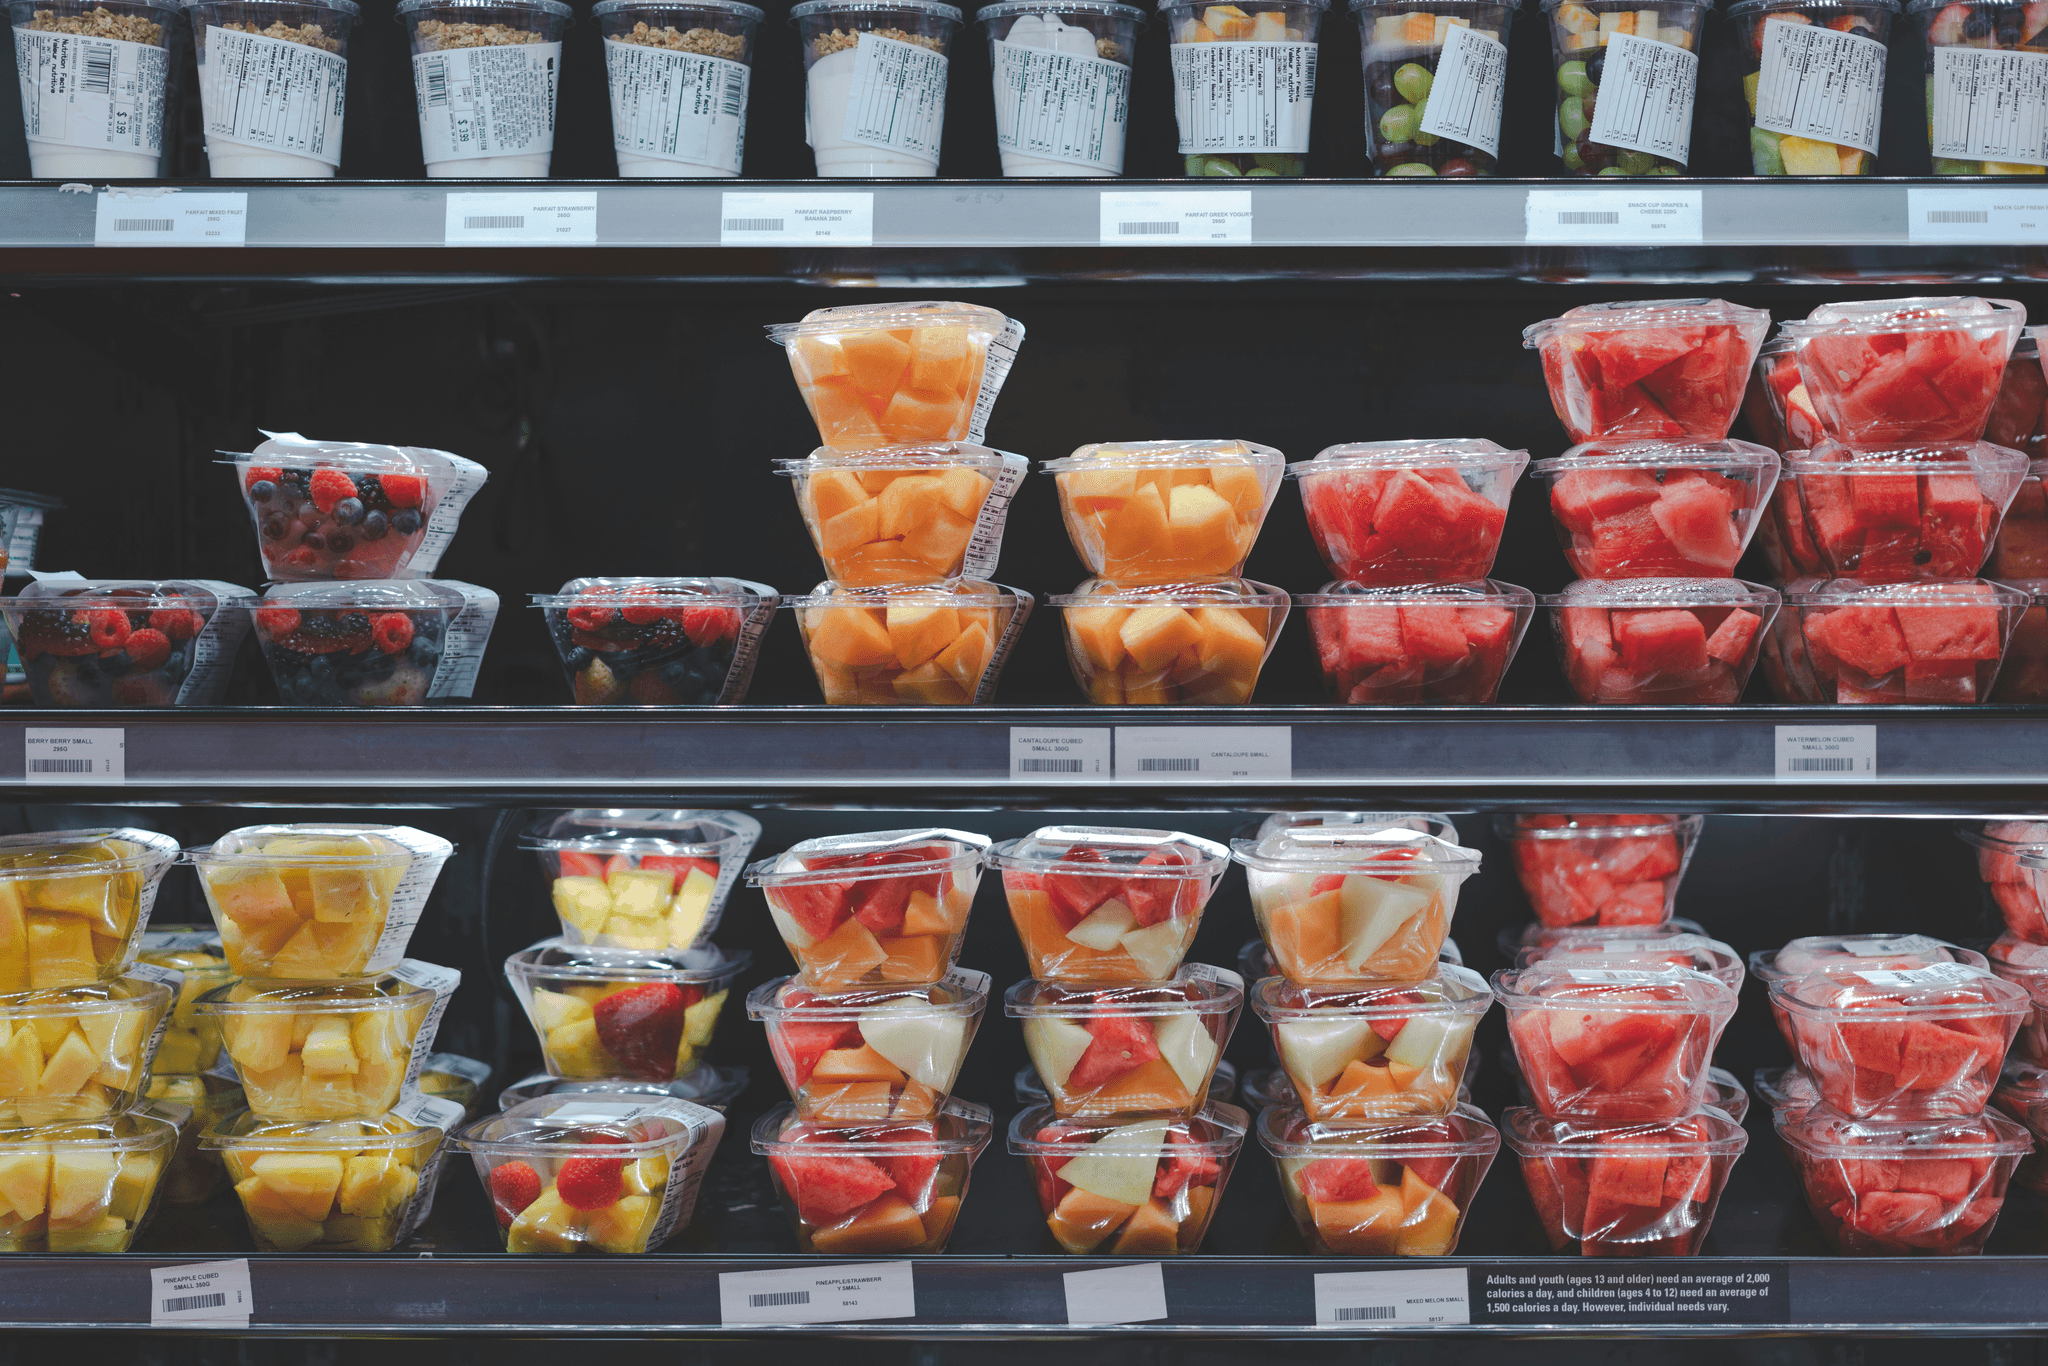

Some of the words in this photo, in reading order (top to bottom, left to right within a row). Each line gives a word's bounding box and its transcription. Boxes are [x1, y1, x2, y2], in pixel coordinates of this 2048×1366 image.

[60, 39, 69, 68] Nutrition
[1830, 36, 1841, 65] Carbohydrate
[698, 61, 706, 81] Valeur
[705, 62, 715, 91] Nutrition
[694, 85, 703, 114] nutritive
[703, 95, 711, 114] Facts
[117, 121, 126, 134] 3.99
[459, 128, 469, 142] 3.99
[163, 1275, 196, 1284] PINEAPPLE
[815, 1276, 882, 1286] PINEAPPLE/STRAWBERR
[1487, 1275, 1516, 1284] Adults
[1519, 1275, 1536, 1284] and
[1539, 1275, 1564, 1286] youth
[1567, 1275, 1592, 1286] (ages
[1595, 1275, 1605, 1284] 13
[1608, 1275, 1624, 1284] and
[1627, 1274, 1654, 1284] older)
[1656, 1274, 1679, 1283] need
[1696, 1276, 1733, 1285] average
[1736, 1273, 1744, 1282] of
[1746, 1274, 1770, 1284] 2,000
[1487, 1289, 1525, 1298] calories
[1536, 1288, 1554, 1300] day,
[1557, 1288, 1574, 1298] and
[1577, 1288, 1614, 1298] children
[1618, 1288, 1643, 1299] (ages
[1645, 1288, 1650, 1297] 4
[1653, 1289, 1661, 1297] to
[1664, 1288, 1677, 1298] 12)
[1680, 1288, 1703, 1297] need
[1720, 1288, 1757, 1298] average
[1759, 1287, 1768, 1296] of
[1487, 1303, 1510, 1313] 1,500
[1512, 1303, 1550, 1312] calories
[1562, 1302, 1580, 1314] day.
[1583, 1302, 1626, 1313] However,
[1629, 1302, 1674, 1311] individual
[1677, 1302, 1705, 1311] needs
[1708, 1303, 1729, 1313] vary.
